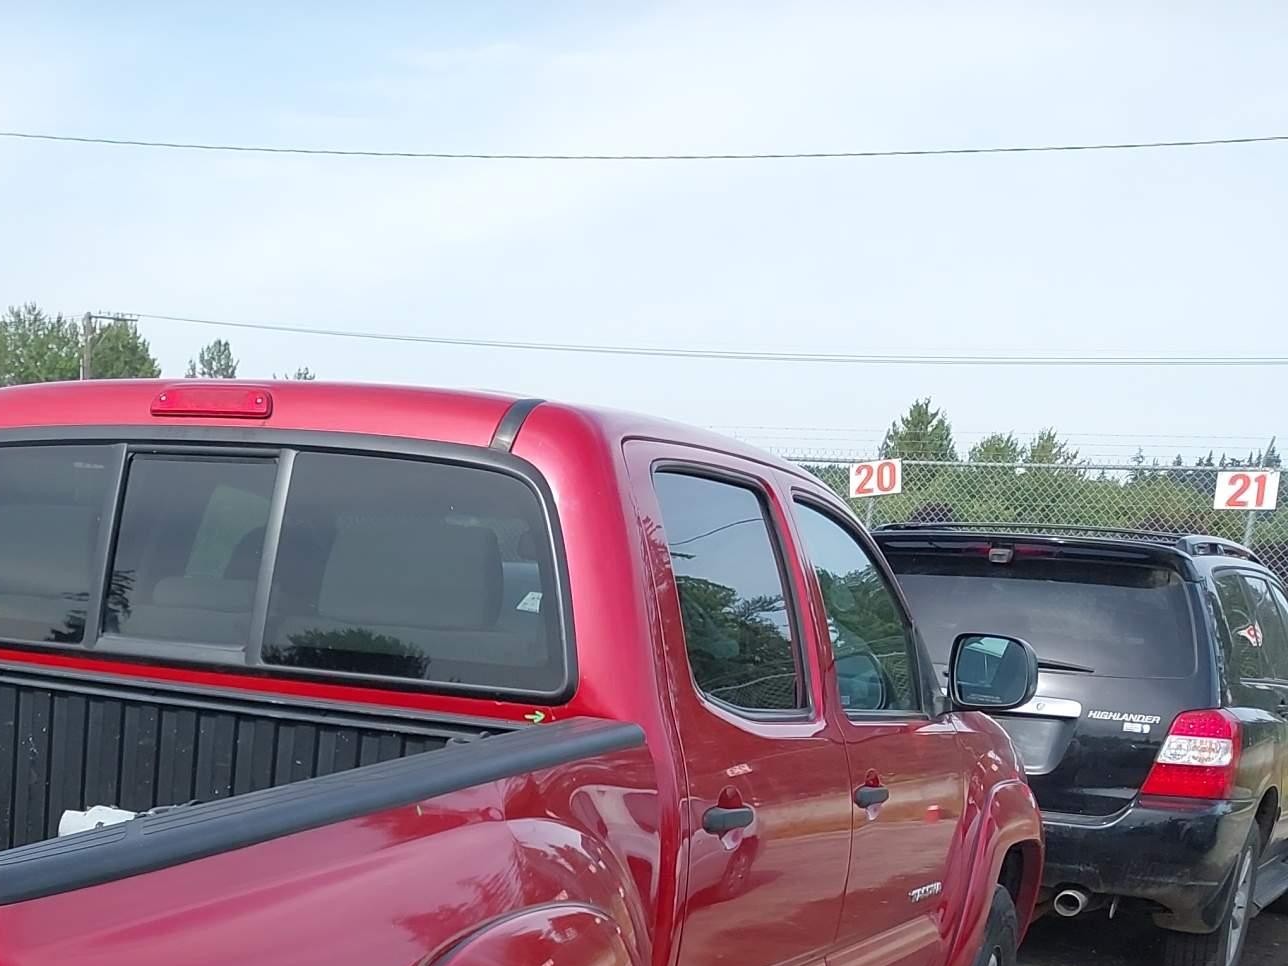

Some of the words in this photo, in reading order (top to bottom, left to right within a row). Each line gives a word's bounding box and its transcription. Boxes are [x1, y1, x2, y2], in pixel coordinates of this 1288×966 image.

[854, 461, 897, 495] 20
[1225, 472, 1268, 507] 21
[1087, 709, 1161, 724] HIGHLANDER
